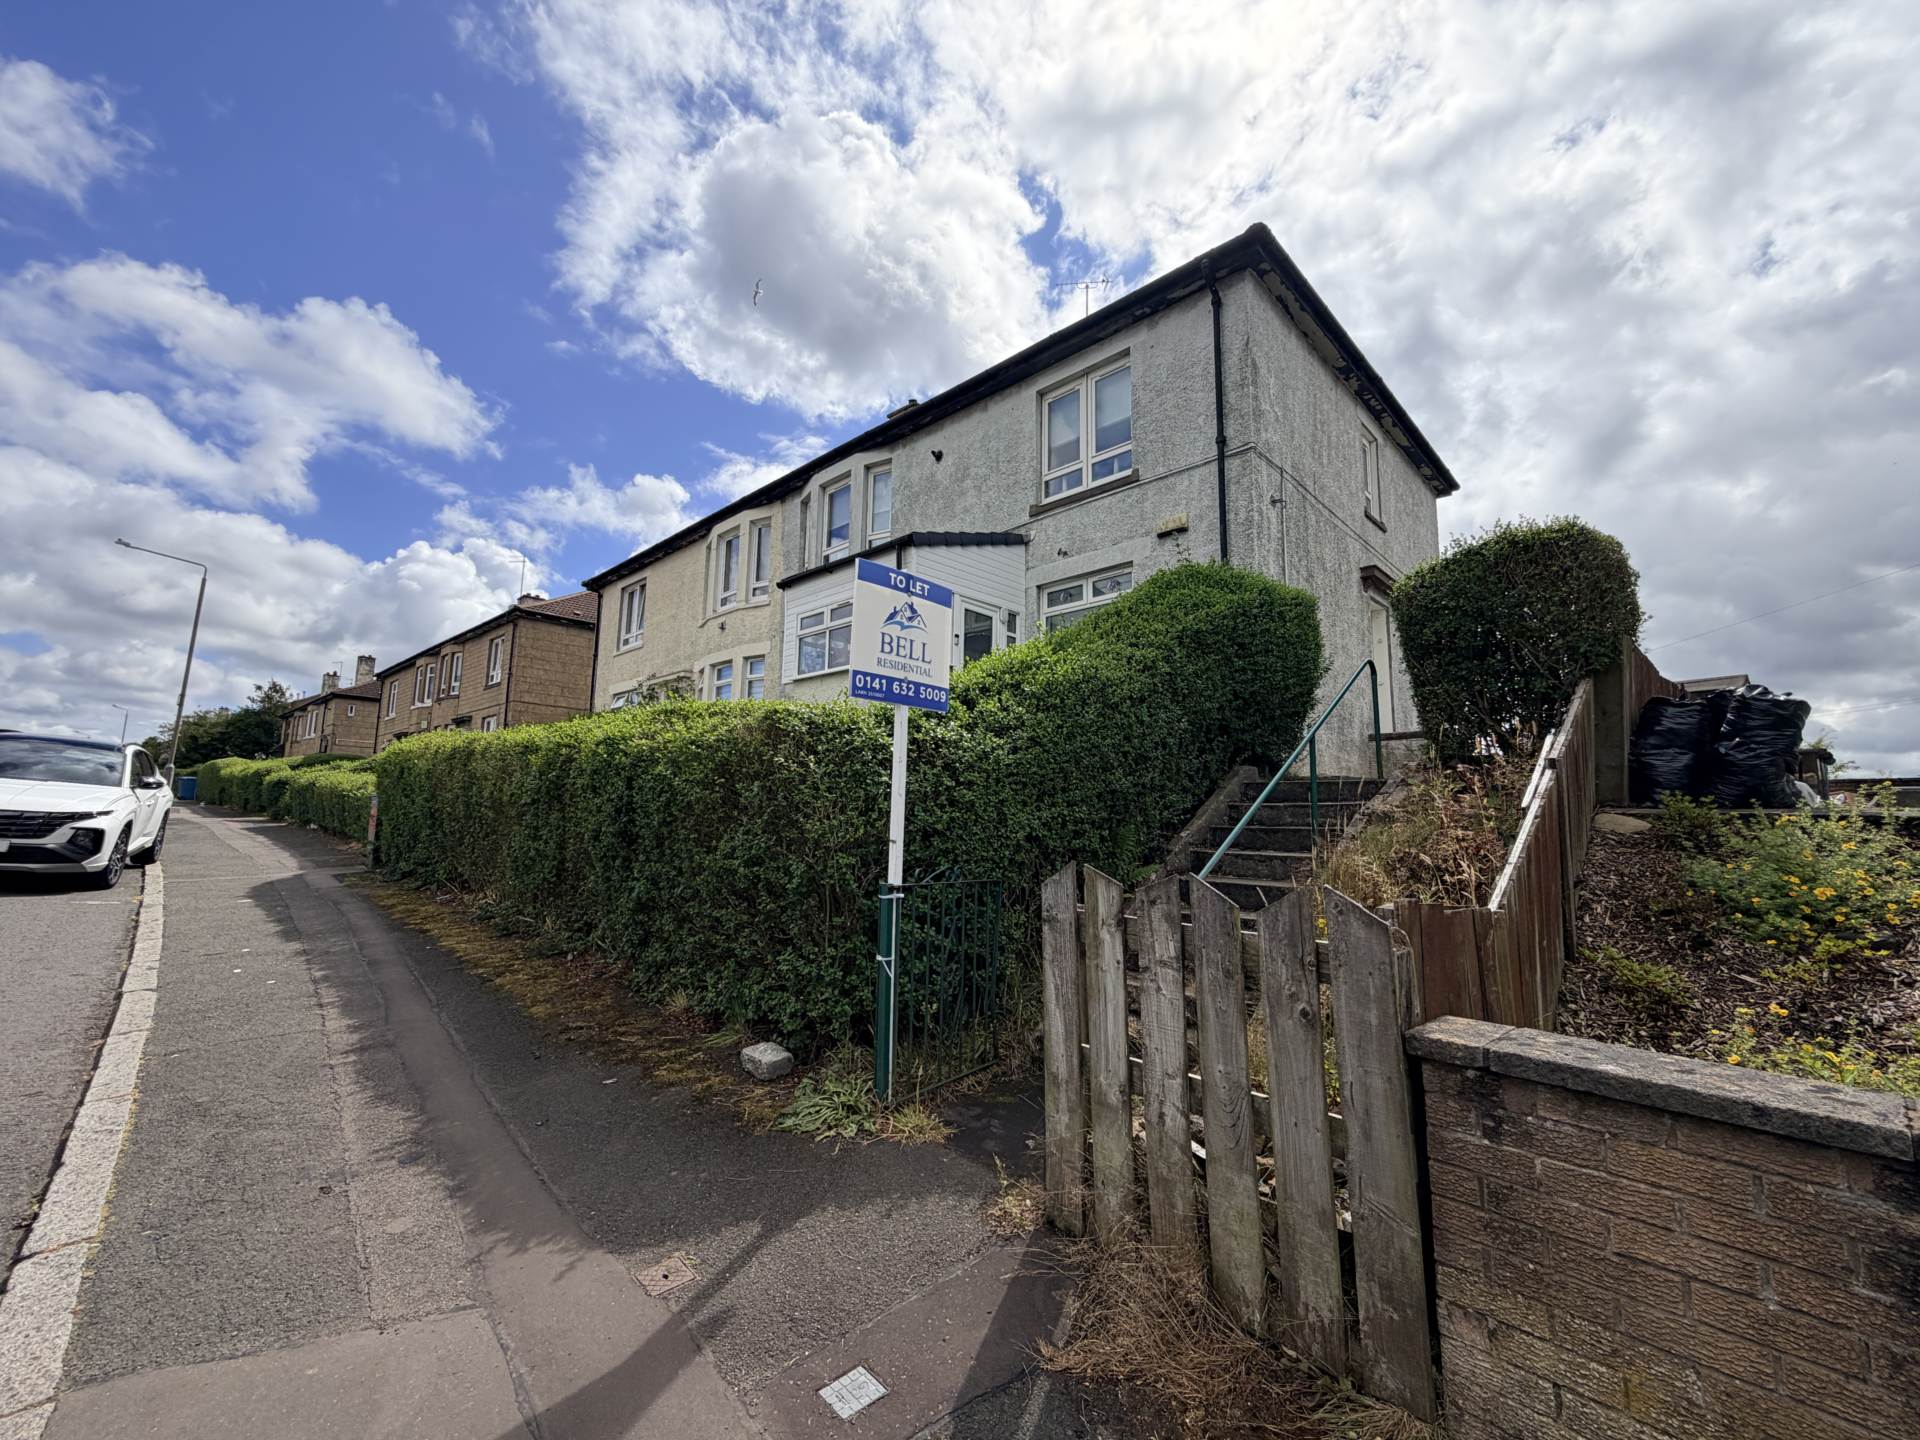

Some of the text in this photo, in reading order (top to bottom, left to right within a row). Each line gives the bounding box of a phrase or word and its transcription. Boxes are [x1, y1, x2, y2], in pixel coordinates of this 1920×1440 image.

[888, 572, 930, 596] TO LET
[880, 631, 932, 664] BELL
[876, 657, 933, 678] RESIDENTIAL
[855, 674, 887, 691] 0141
[892, 681, 915, 697] 632
[919, 686, 946, 703] 5009
